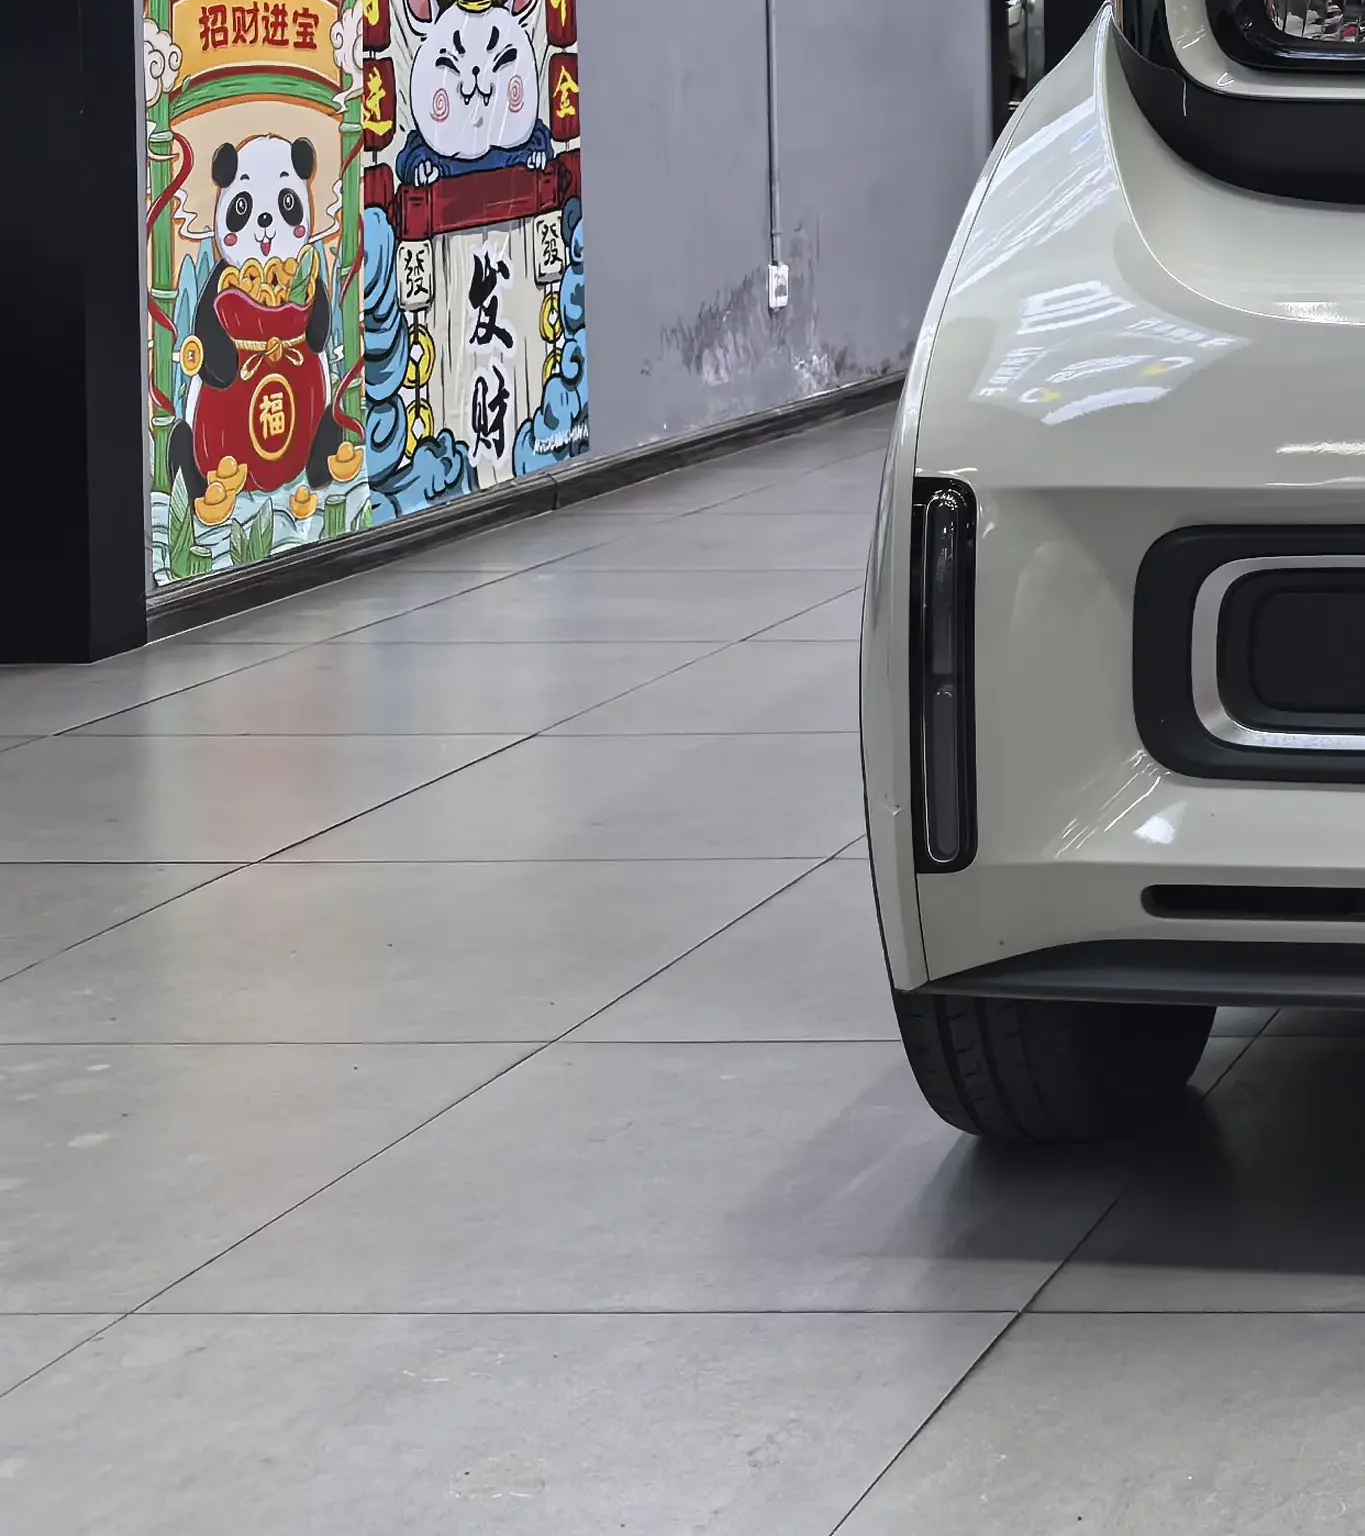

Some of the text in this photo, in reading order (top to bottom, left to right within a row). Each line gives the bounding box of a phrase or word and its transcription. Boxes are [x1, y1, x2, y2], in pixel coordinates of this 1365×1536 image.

[198, 1, 320, 52] 招财进宝
[259, 392, 286, 440] 福
